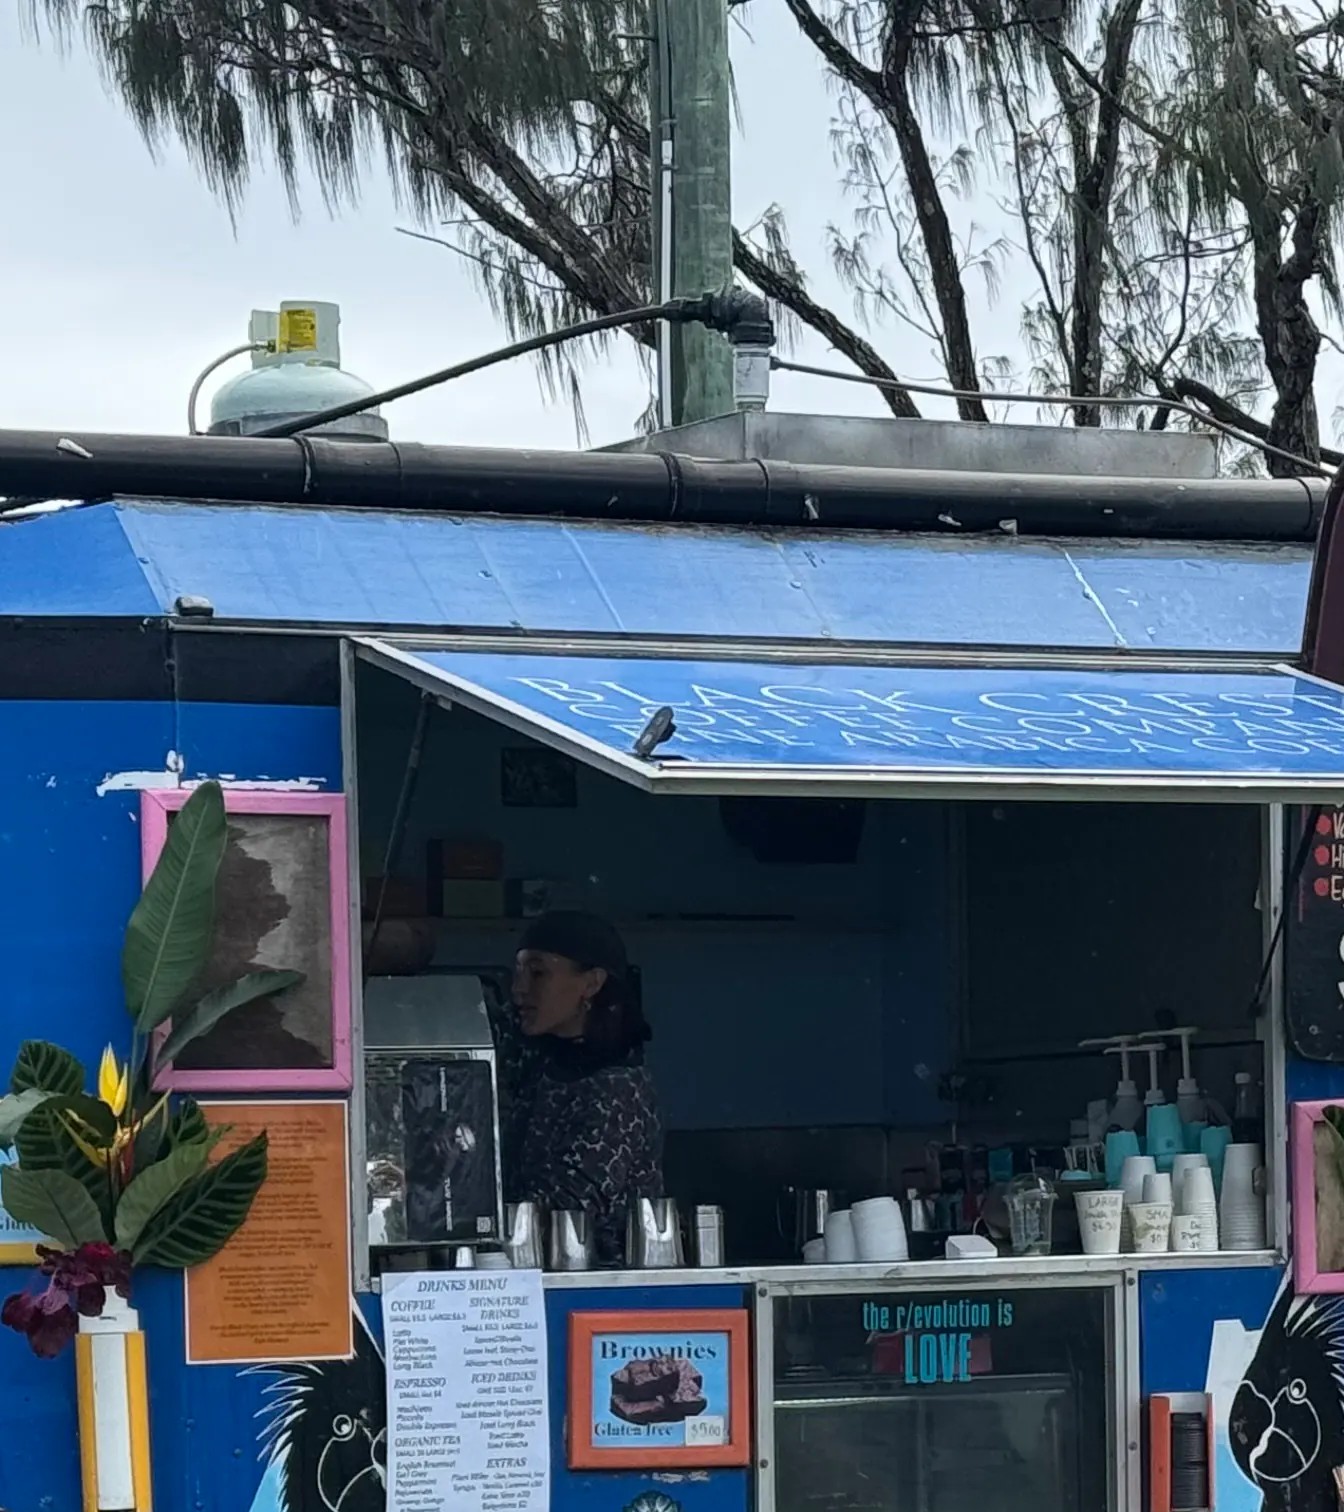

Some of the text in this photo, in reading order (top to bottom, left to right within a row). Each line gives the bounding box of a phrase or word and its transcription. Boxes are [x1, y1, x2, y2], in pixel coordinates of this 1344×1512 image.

[508, 676, 952, 713] BLACK
[568, 702, 943, 731] COFFEE
[417, 1277, 508, 1293] DRINKS MENU
[862, 1300, 889, 1331] the
[997, 1298, 1014, 1328] is
[600, 1340, 718, 1361] Brownies
[904, 1332, 973, 1384] LOVE
